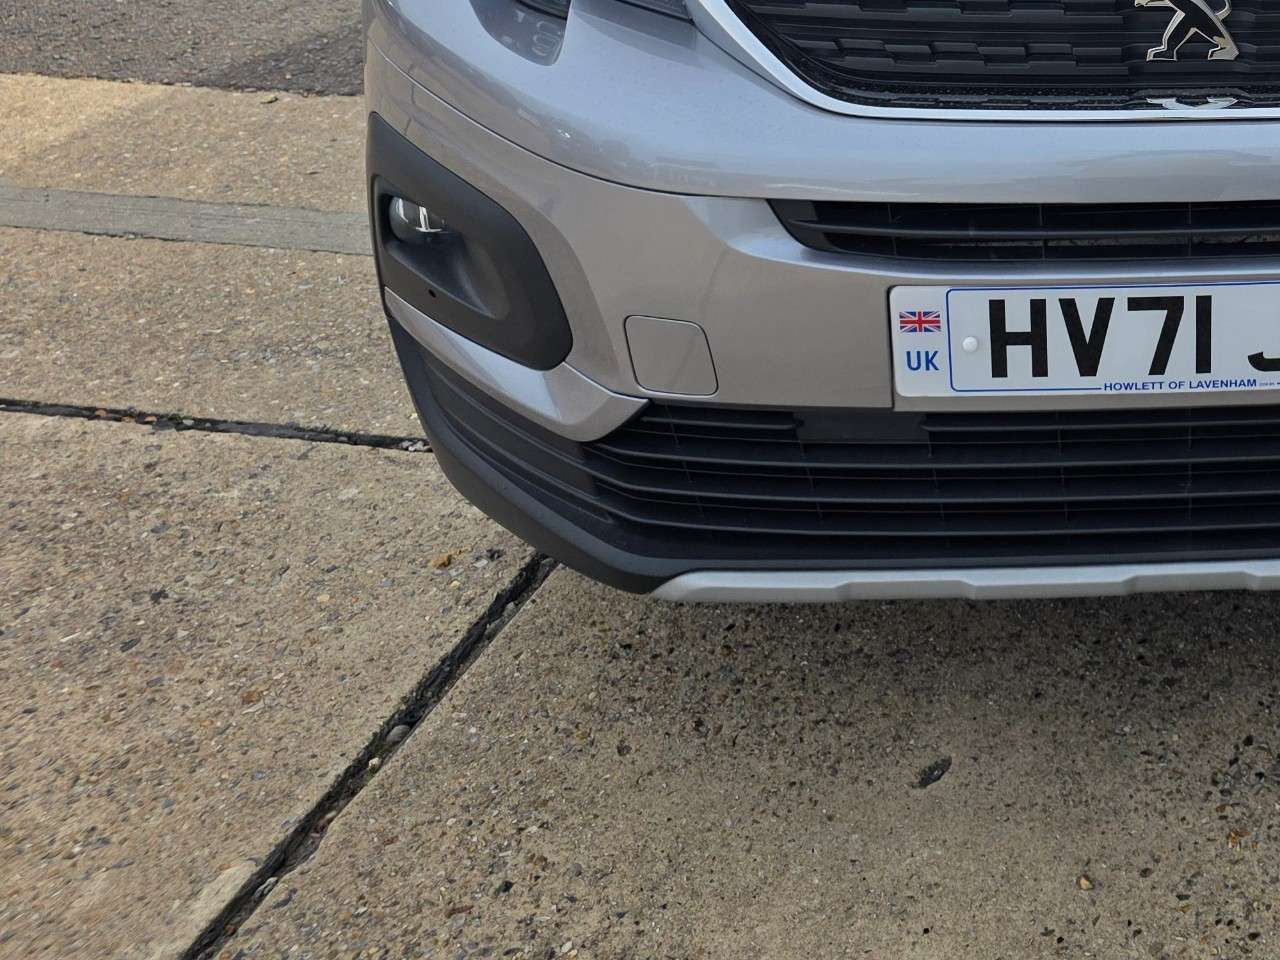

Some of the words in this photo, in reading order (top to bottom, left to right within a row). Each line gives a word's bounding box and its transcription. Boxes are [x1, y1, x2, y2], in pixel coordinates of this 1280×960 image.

[988, 294, 1213, 379] HV71
[905, 350, 940, 371] UK
[1103, 381, 1165, 391] HOWLETT
[1168, 380, 1186, 390] OF
[1189, 379, 1257, 390] LAVENHAM
